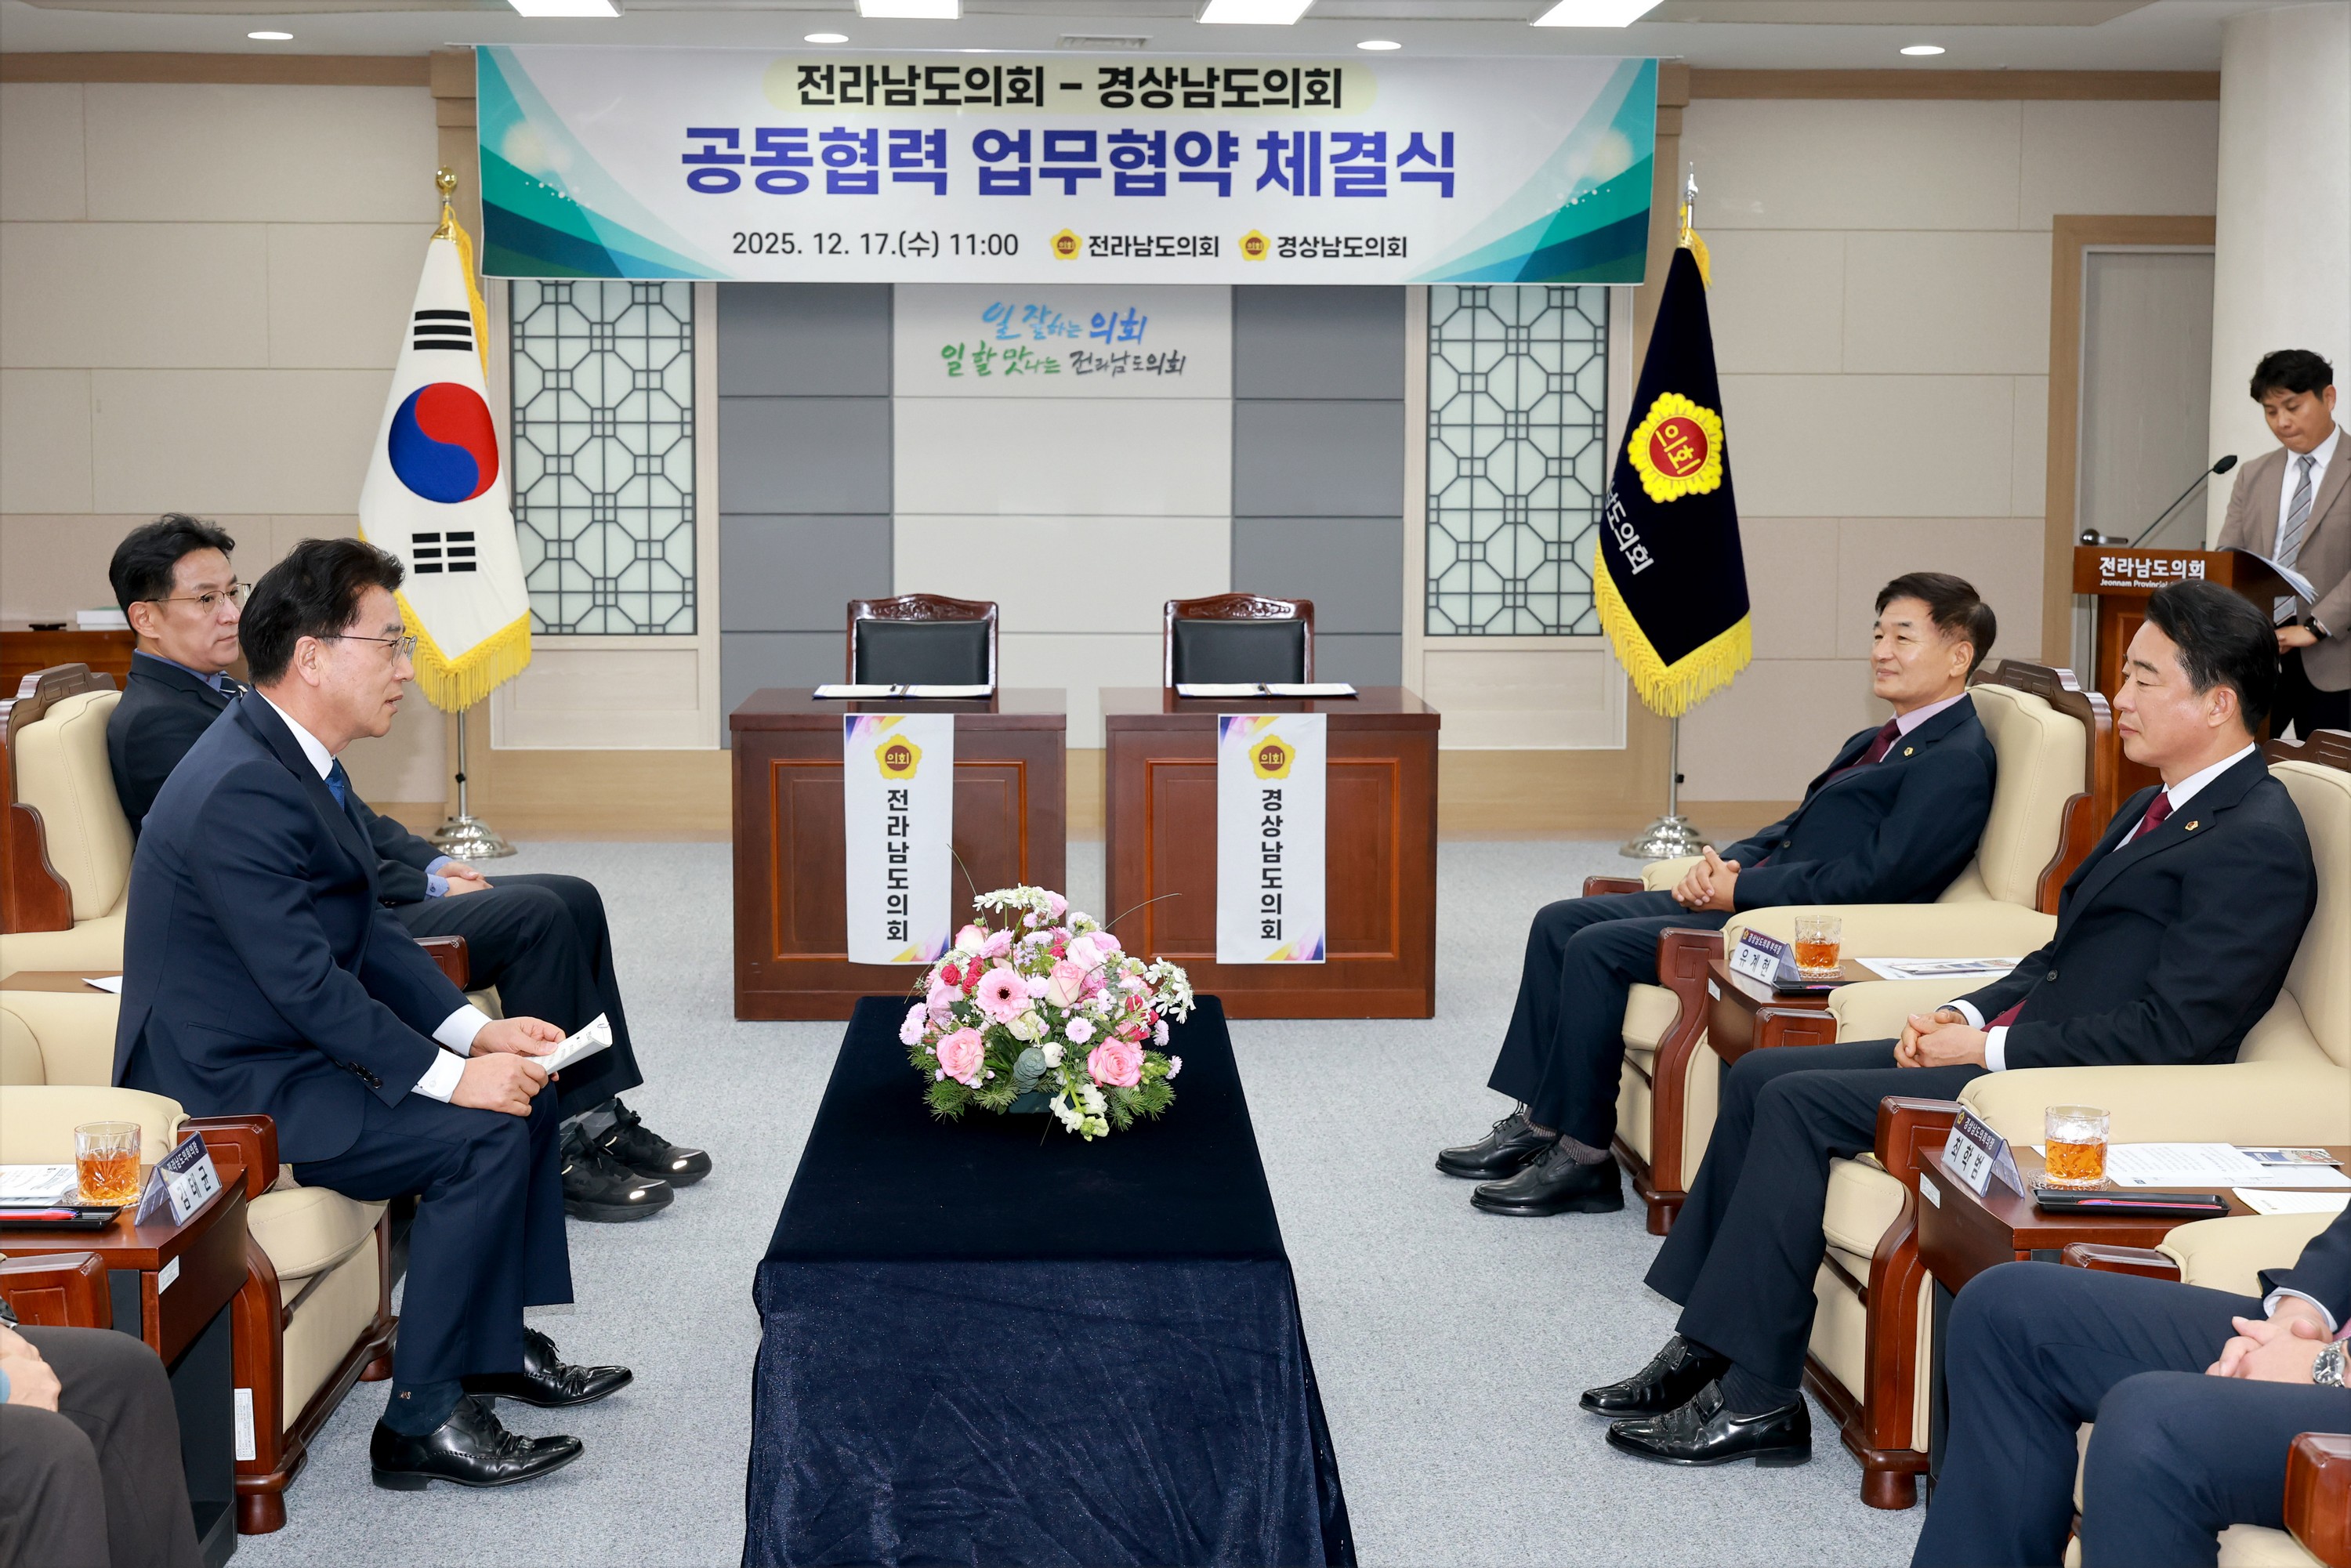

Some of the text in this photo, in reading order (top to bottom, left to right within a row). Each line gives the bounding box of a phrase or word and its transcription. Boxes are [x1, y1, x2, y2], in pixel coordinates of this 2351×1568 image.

[797, 64, 1044, 107] 전라남도의회
[1098, 66, 1342, 109] 경상남도의회
[681, 126, 1455, 198] 공동협력 업무협약 체결식
[733, 230, 1019, 259] 2025. 12. 17.(수) 11:00
[1089, 235, 1219, 258] 전라남도의회
[1277, 236, 1407, 259] 경상남도의회
[982, 302, 1021, 339] 일
[1089, 306, 1148, 345] 의회
[940, 342, 965, 378] 일
[1069, 349, 1186, 378] 전라남도의회
[1655, 424, 1701, 475] 의회
[2099, 556, 2205, 581] 전라남도의회
[2099, 578, 2132, 588] Jeonnam
[886, 752, 910, 765] 의회
[1260, 752, 1284, 765] 의회
[886, 789, 910, 942] 전라남도의회
[1260, 788, 1284, 941] 경상남도의회
